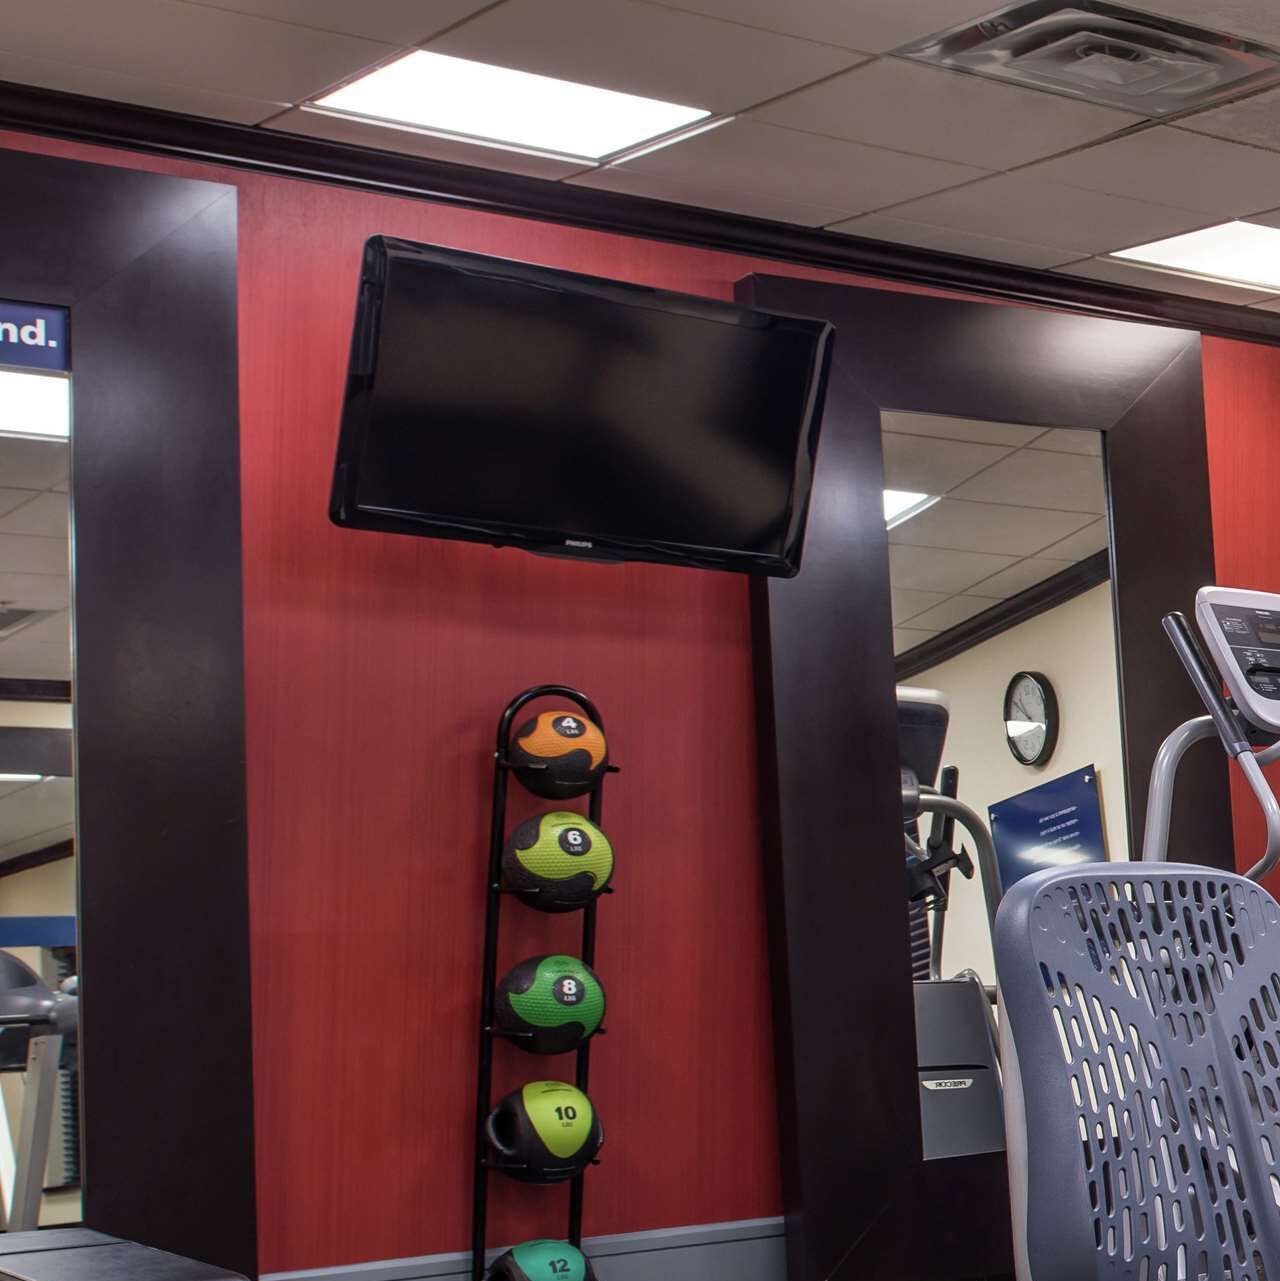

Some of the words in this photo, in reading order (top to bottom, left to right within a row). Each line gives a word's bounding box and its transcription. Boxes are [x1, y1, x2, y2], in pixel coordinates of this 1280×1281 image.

[561, 717, 577, 729] 4
[567, 830, 583, 845] 6
[562, 978, 577, 995] 8
[554, 1105, 577, 1121] 10
[548, 1258, 571, 1274] 12
